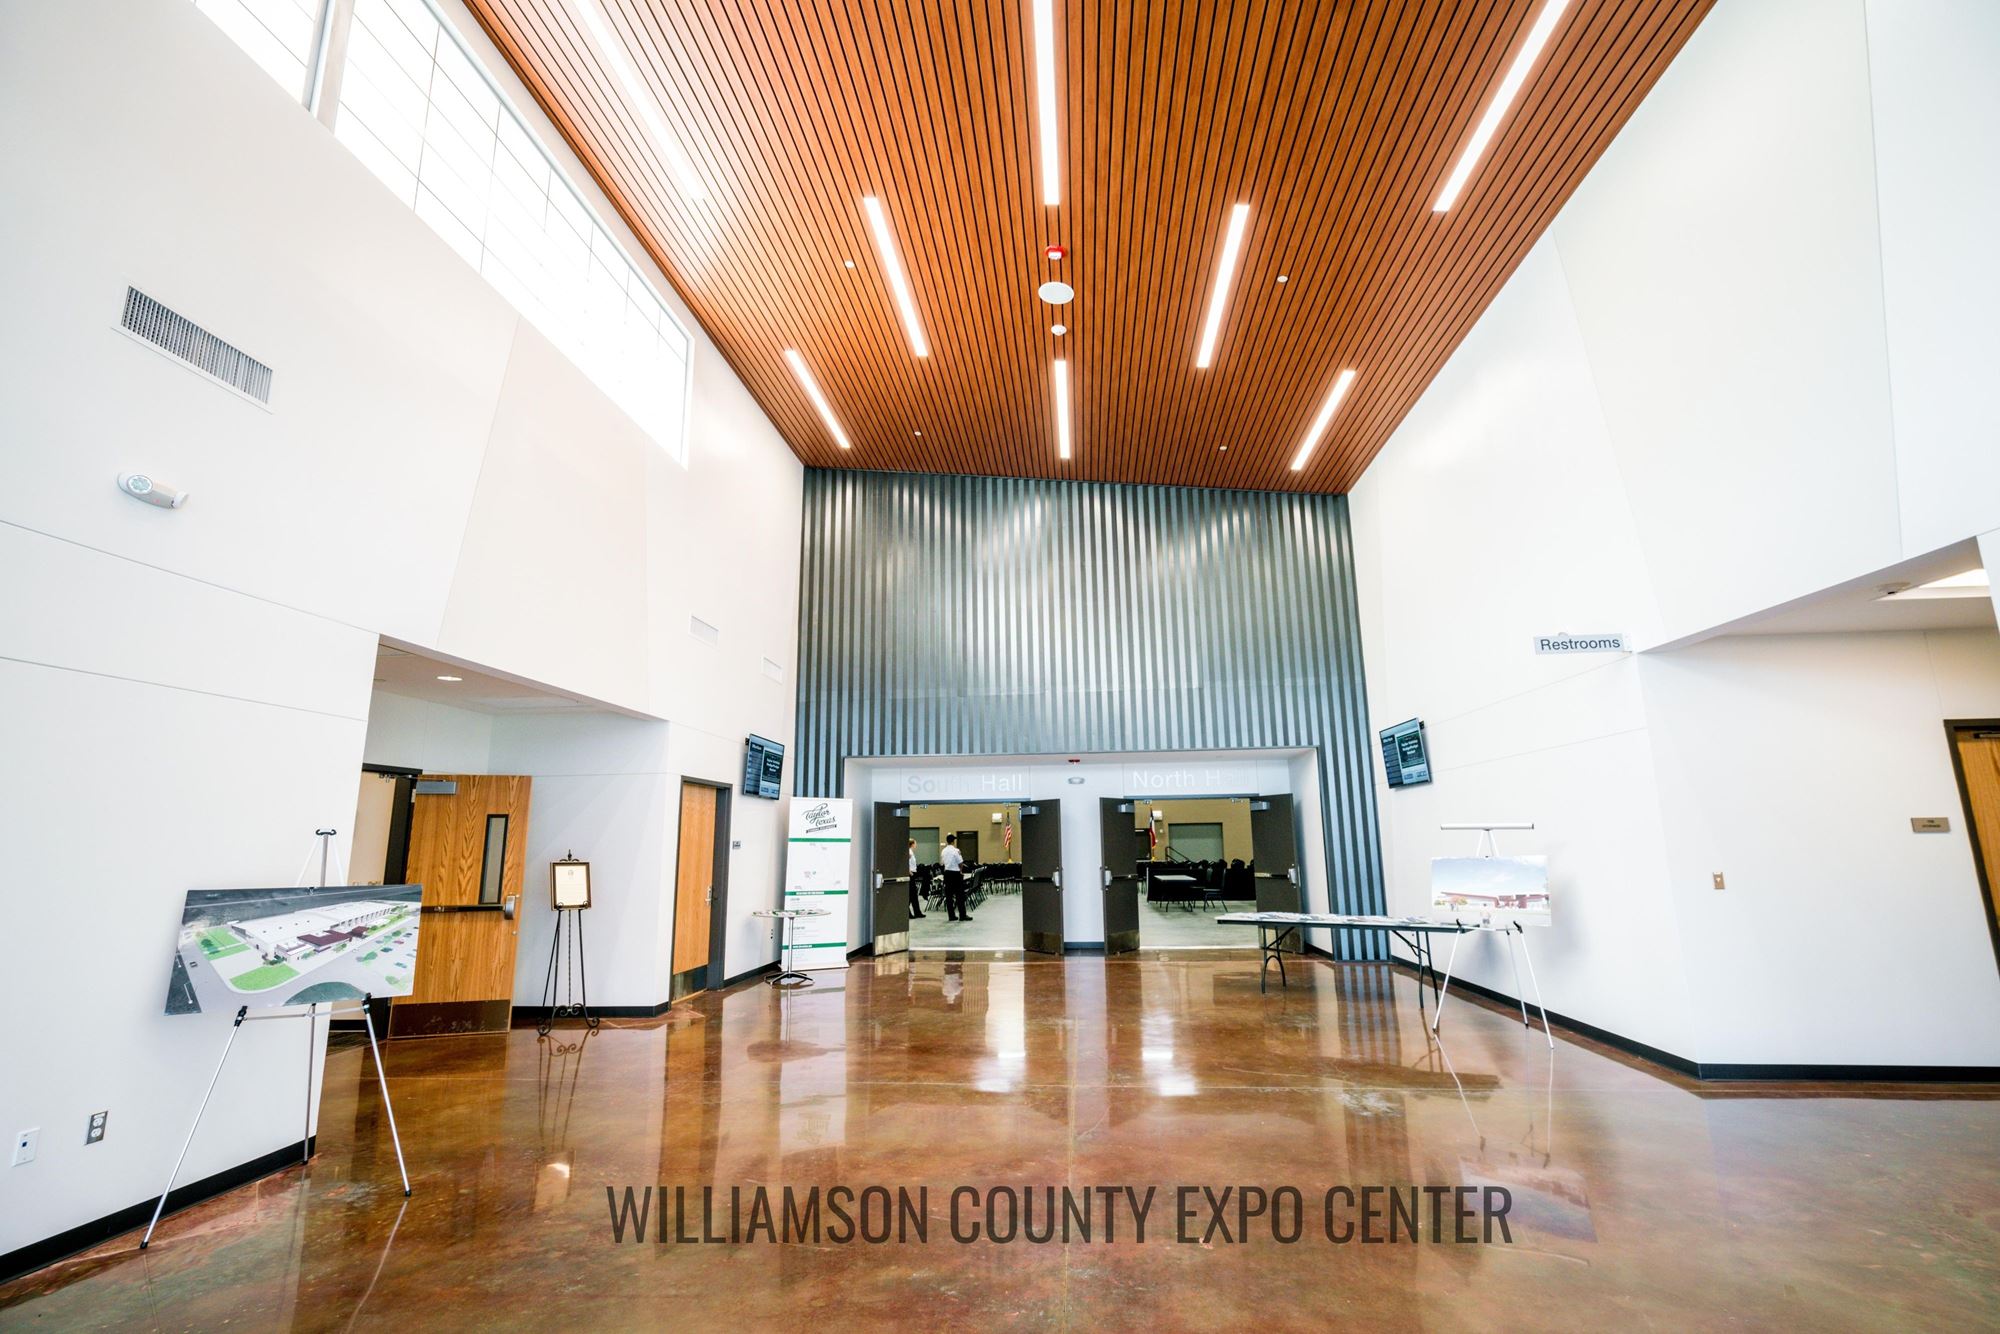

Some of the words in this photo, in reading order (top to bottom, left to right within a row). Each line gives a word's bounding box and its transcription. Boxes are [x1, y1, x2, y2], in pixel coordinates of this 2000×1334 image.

[1540, 638, 1621, 651] Restrooms
[907, 775, 974, 794] Sou
[981, 774, 1024, 792] Hall
[1132, 770, 1195, 789] North
[1205, 769, 1249, 787] Ha
